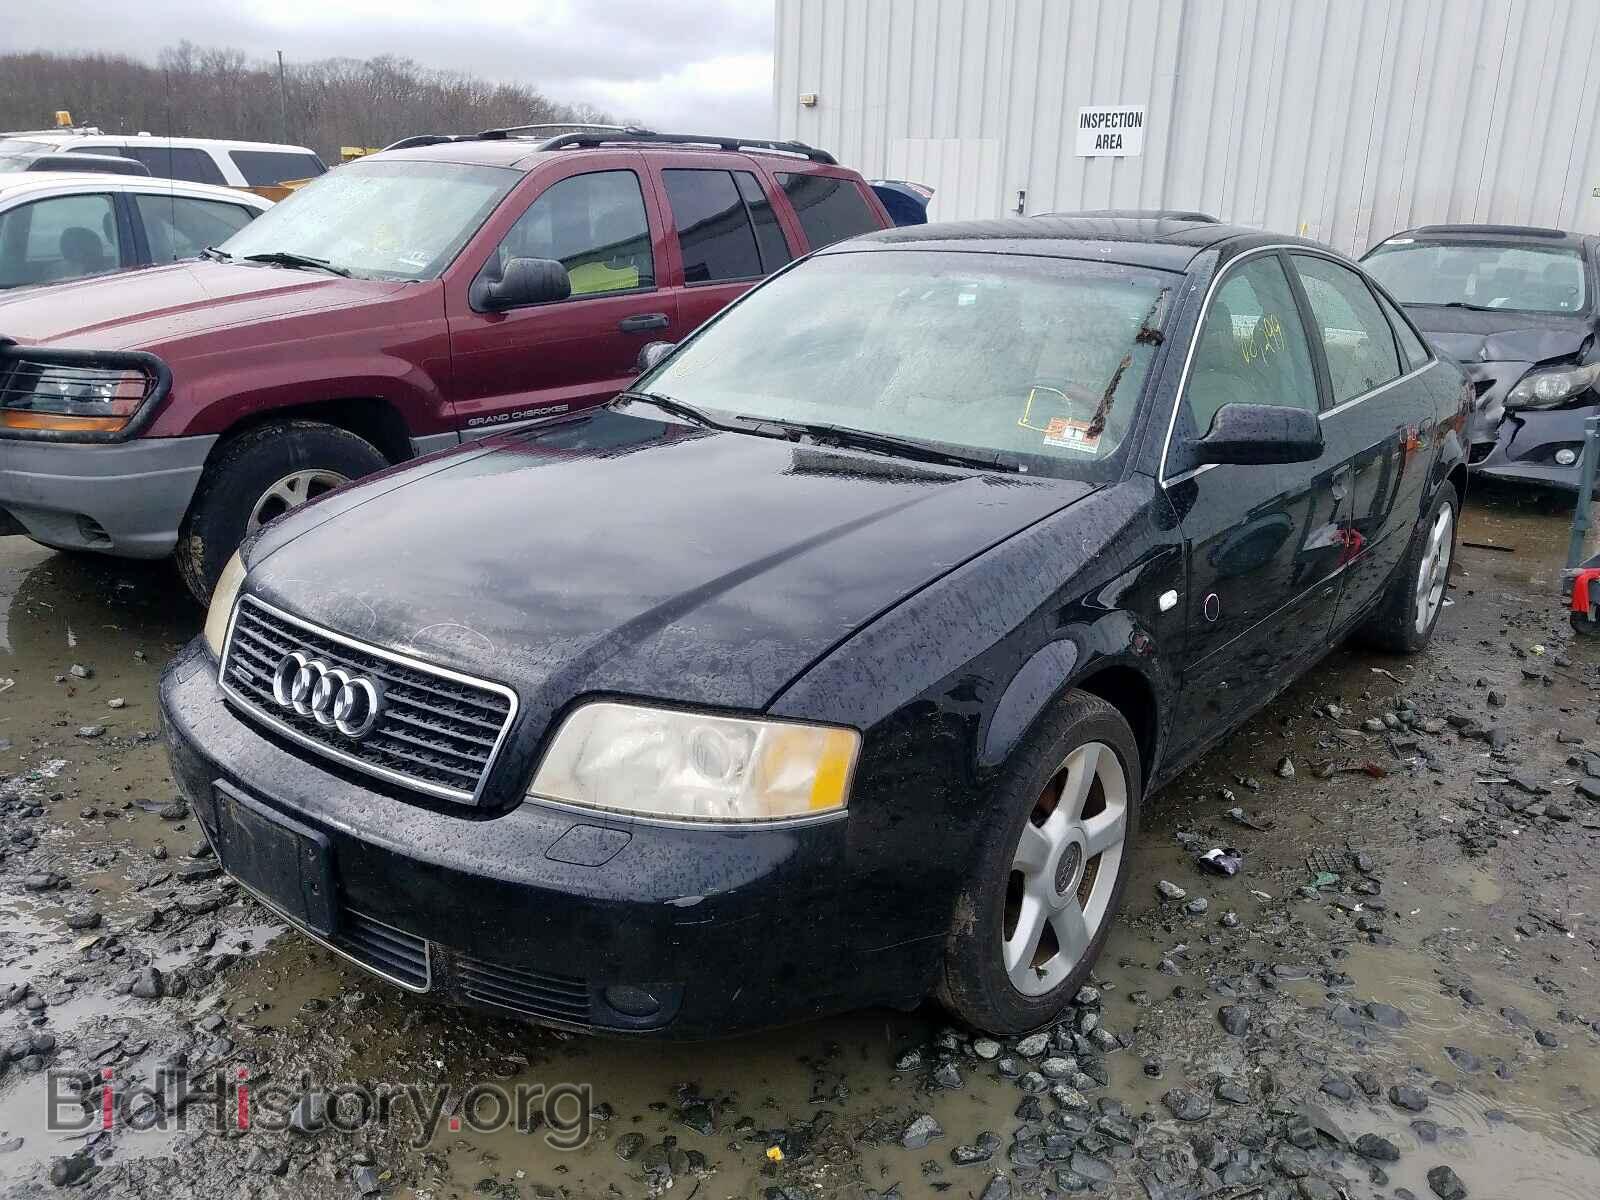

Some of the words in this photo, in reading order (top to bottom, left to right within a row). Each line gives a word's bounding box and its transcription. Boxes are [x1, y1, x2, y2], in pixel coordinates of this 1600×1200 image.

[1080, 112, 1143, 128] INSPECTION
[1095, 134, 1122, 149] AREA
[468, 413, 510, 426] GRAND
[511, 403, 569, 419] CHEROKEE
